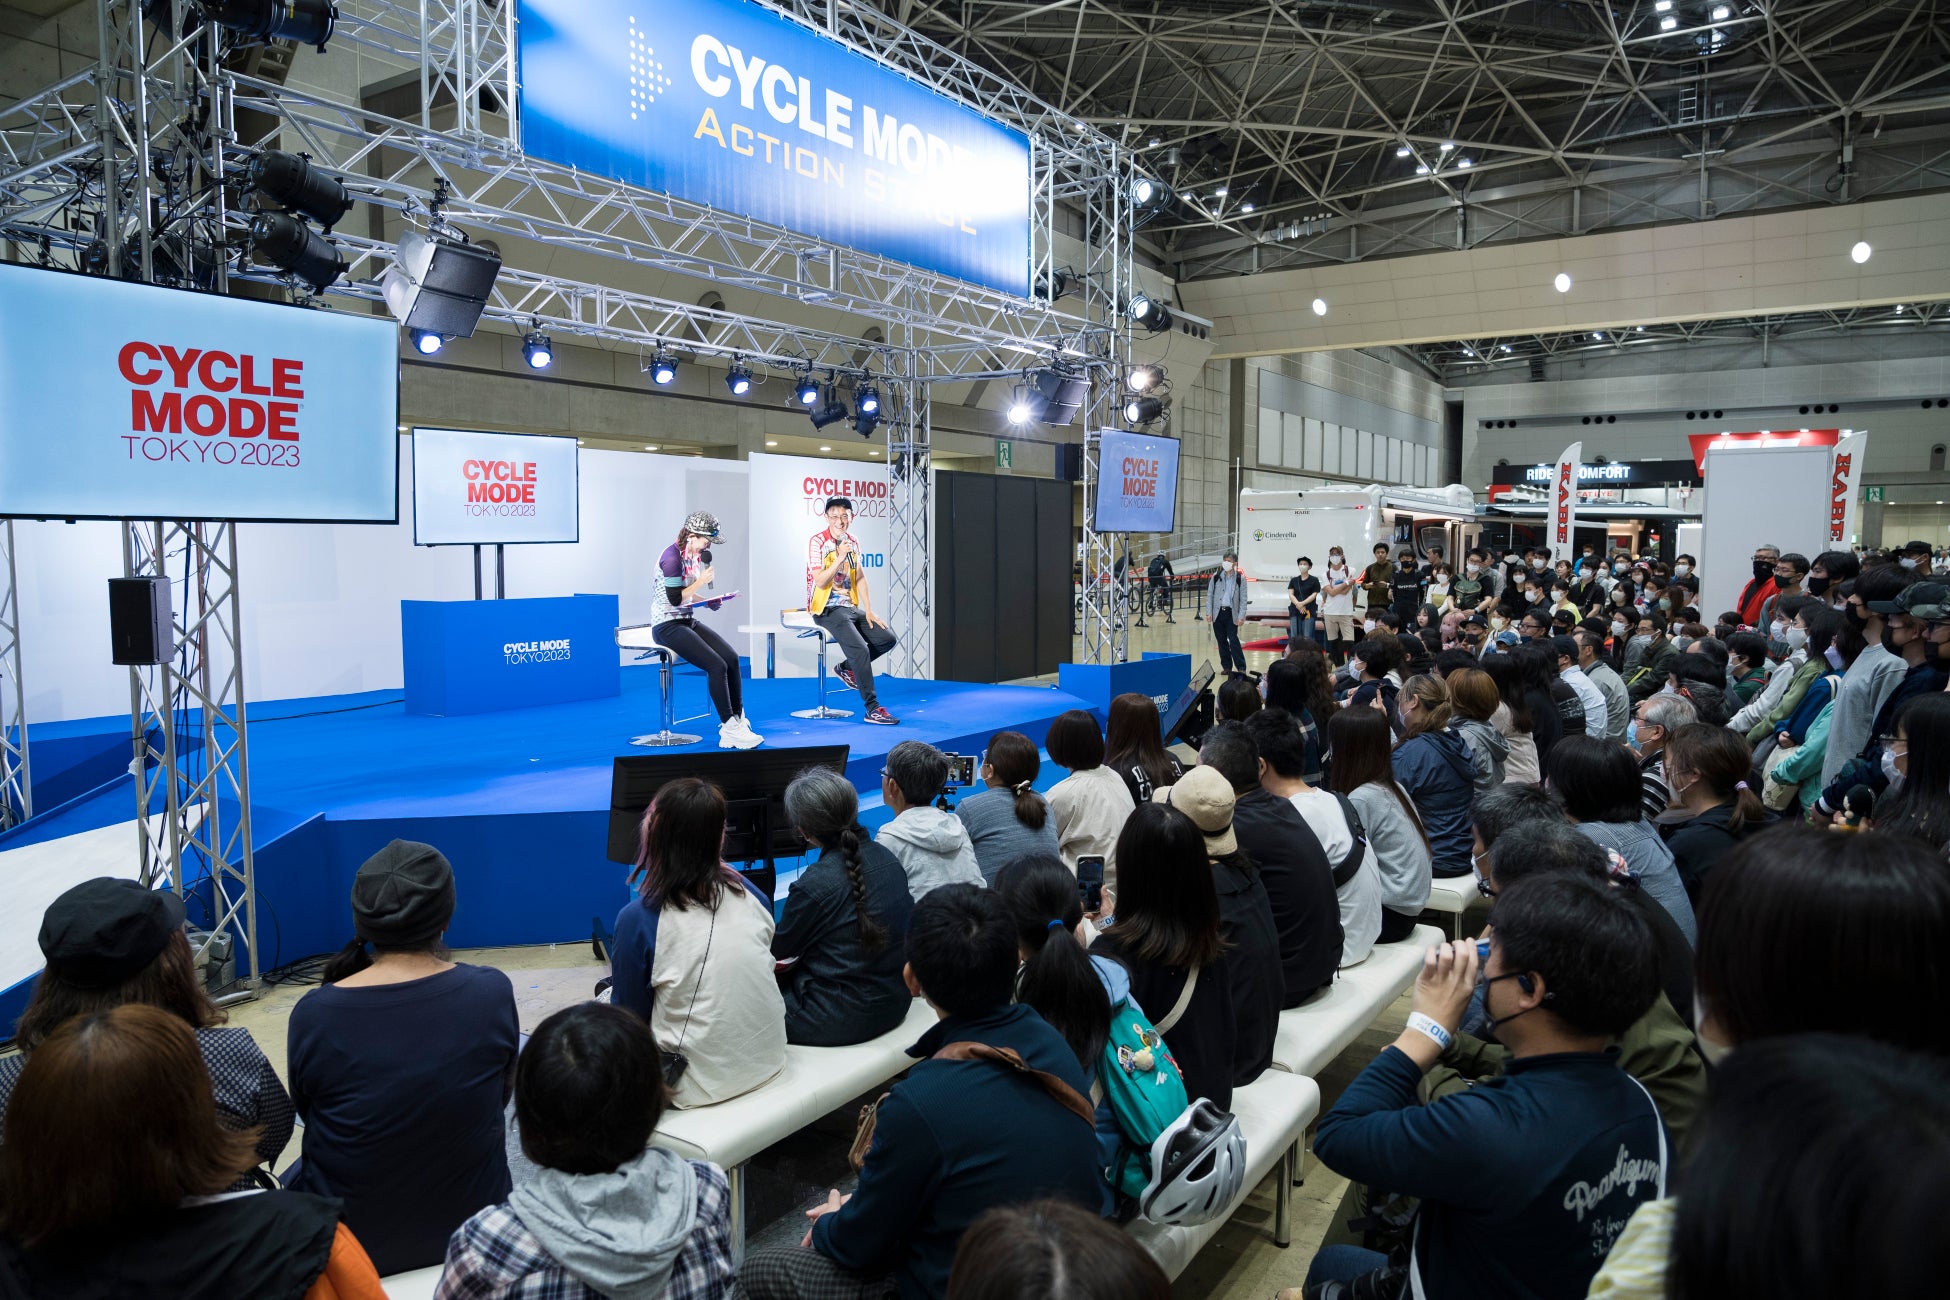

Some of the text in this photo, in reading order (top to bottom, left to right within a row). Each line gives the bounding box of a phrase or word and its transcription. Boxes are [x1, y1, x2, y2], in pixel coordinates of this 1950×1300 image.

[690, 34, 853, 149] CYCLE
[693, 106, 845, 189] ACTION
[118, 341, 304, 399] CYCLE
[131, 389, 300, 441] MODE
[462, 459, 537, 483] CYCLE
[1122, 457, 1159, 478] CYCLE
[1526, 466, 1631, 481] RIDE OMFORT
[467, 482, 536, 504] MODE
[803, 477, 852, 496] CYCLE
[1122, 477, 1157, 497] MODE
[1830, 453, 1852, 542] KABE
[1556, 462, 1572, 544] KABE
[503, 638, 571, 654] CYCLE MODE
